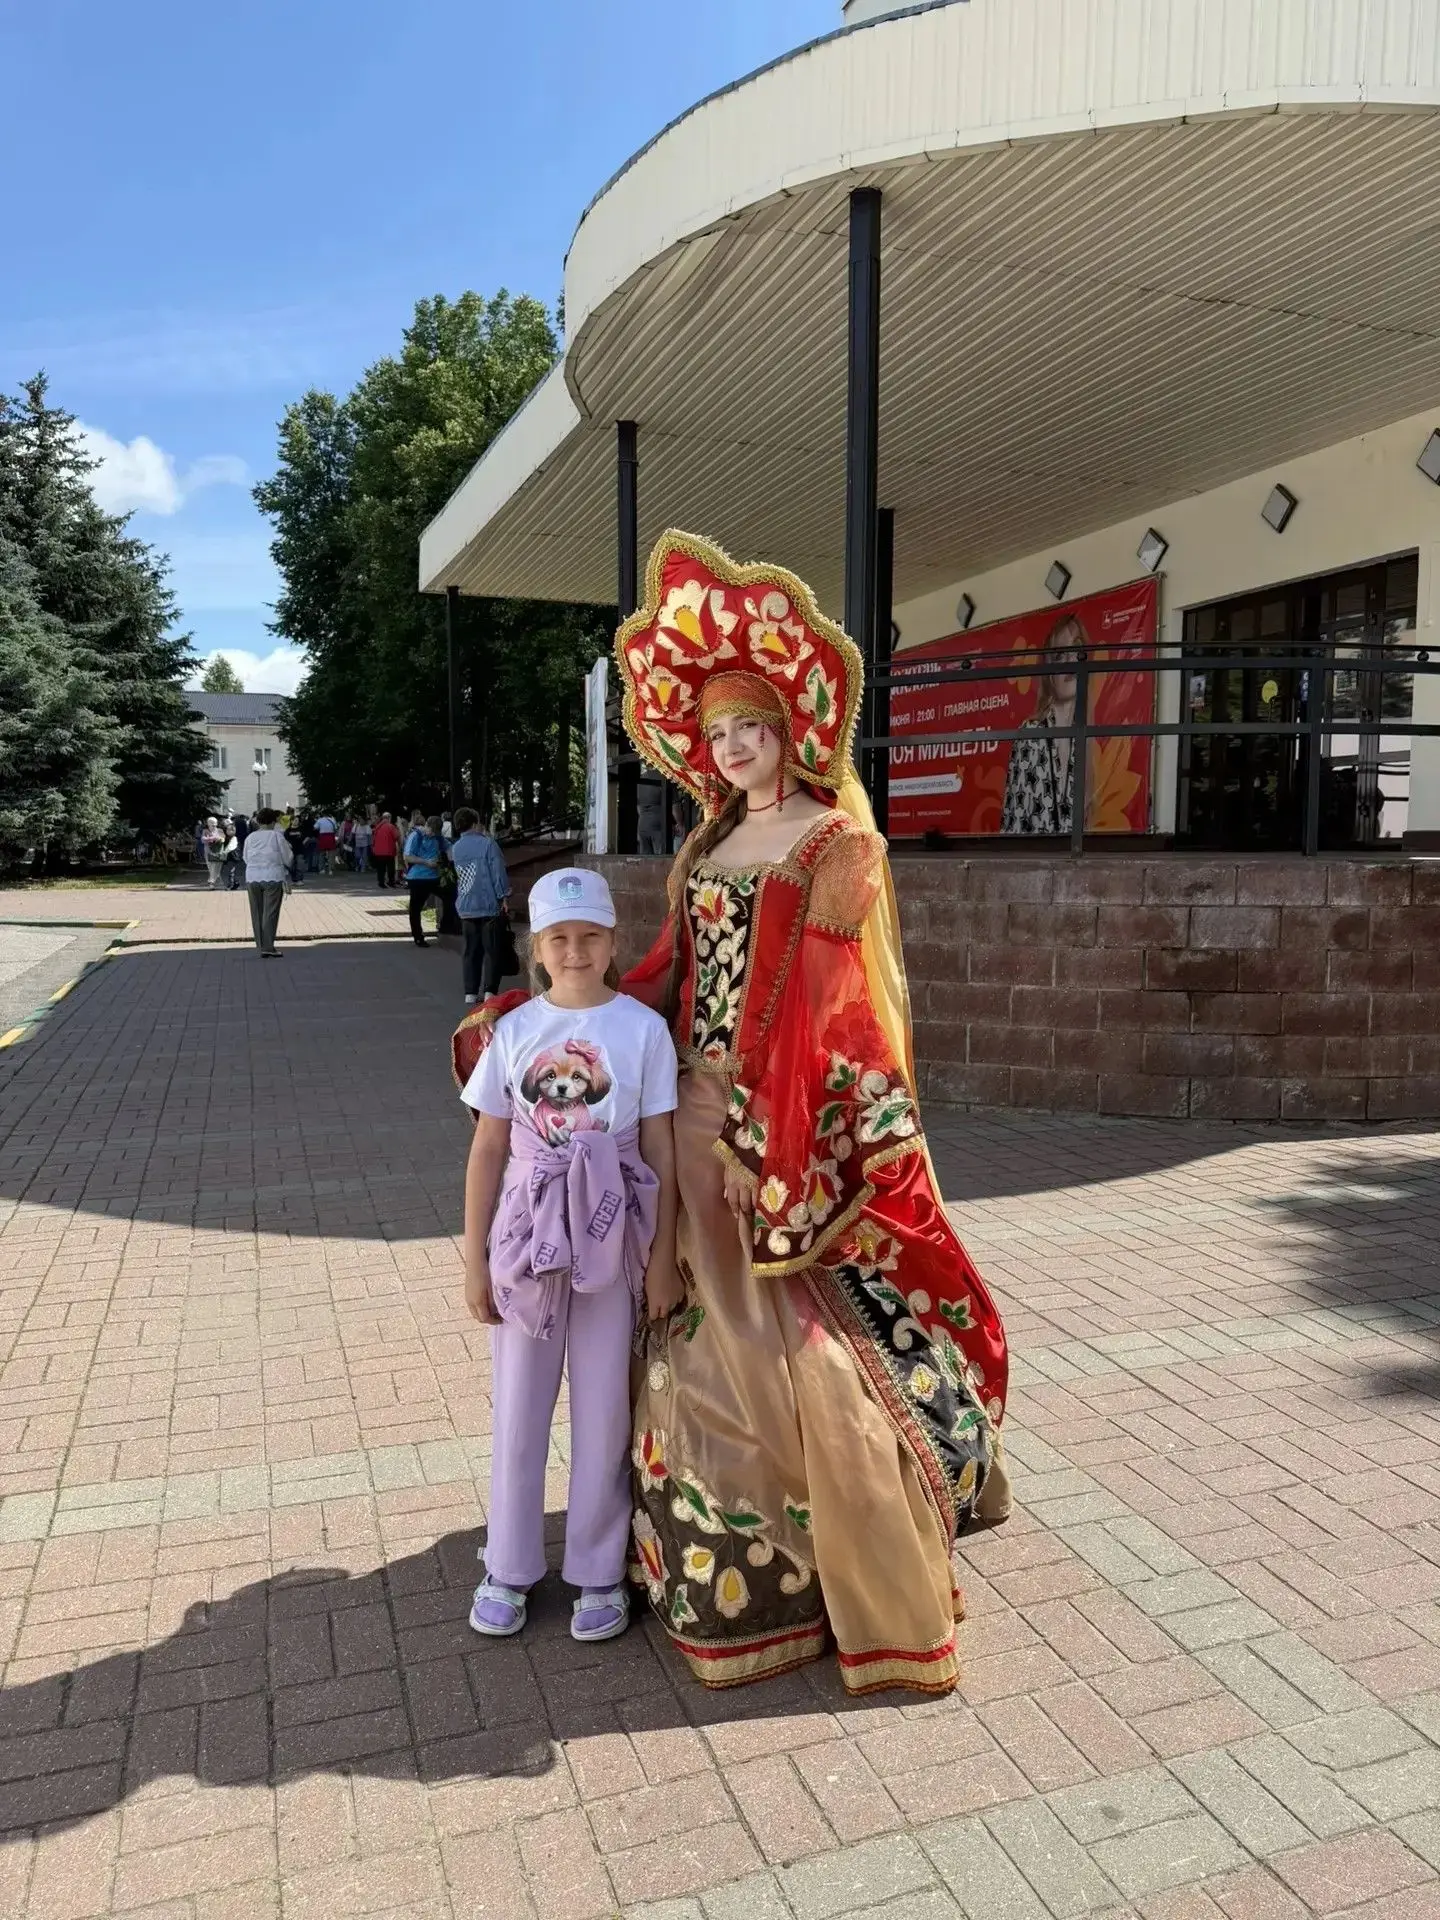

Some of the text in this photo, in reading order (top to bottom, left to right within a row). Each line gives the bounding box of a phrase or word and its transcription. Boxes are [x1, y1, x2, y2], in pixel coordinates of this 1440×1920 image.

[916, 708, 935, 722] 21:00
[944, 699, 979, 717] ГЛАВНАЯ
[980, 694, 1009, 711] СЦЕНА
[888, 727, 1000, 765] ОЯ МИШЕЛЬ
[587, 1190, 622, 1242] READY
